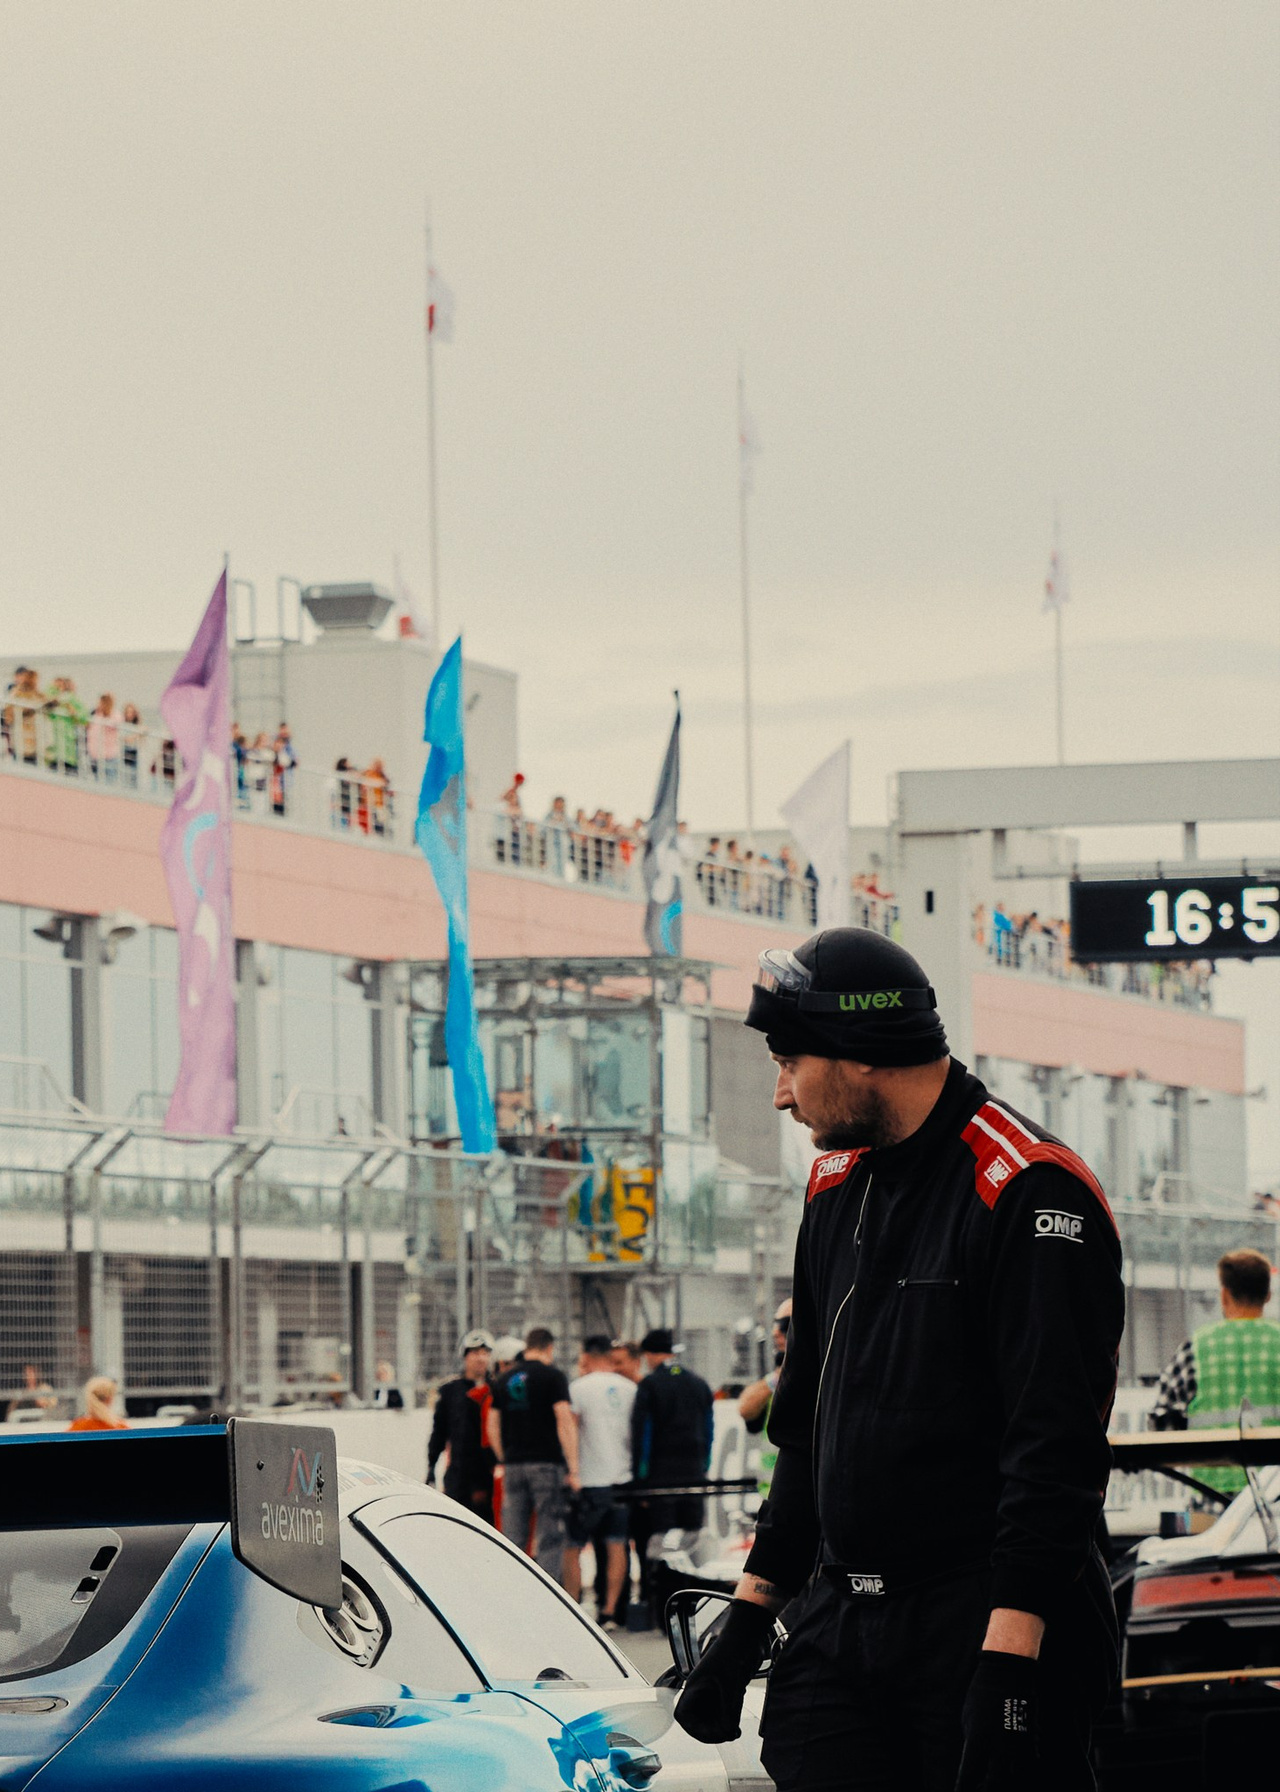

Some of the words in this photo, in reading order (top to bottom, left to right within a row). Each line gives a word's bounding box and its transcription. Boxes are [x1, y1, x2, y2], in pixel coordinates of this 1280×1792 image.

[838, 990, 904, 1011] uvex
[818, 1156, 848, 1176] OMP
[986, 1159, 1008, 1182] OMP
[1035, 1214, 1082, 1236] OMP
[261, 1495, 324, 1545] avexima
[852, 1578, 883, 1593] OMP
